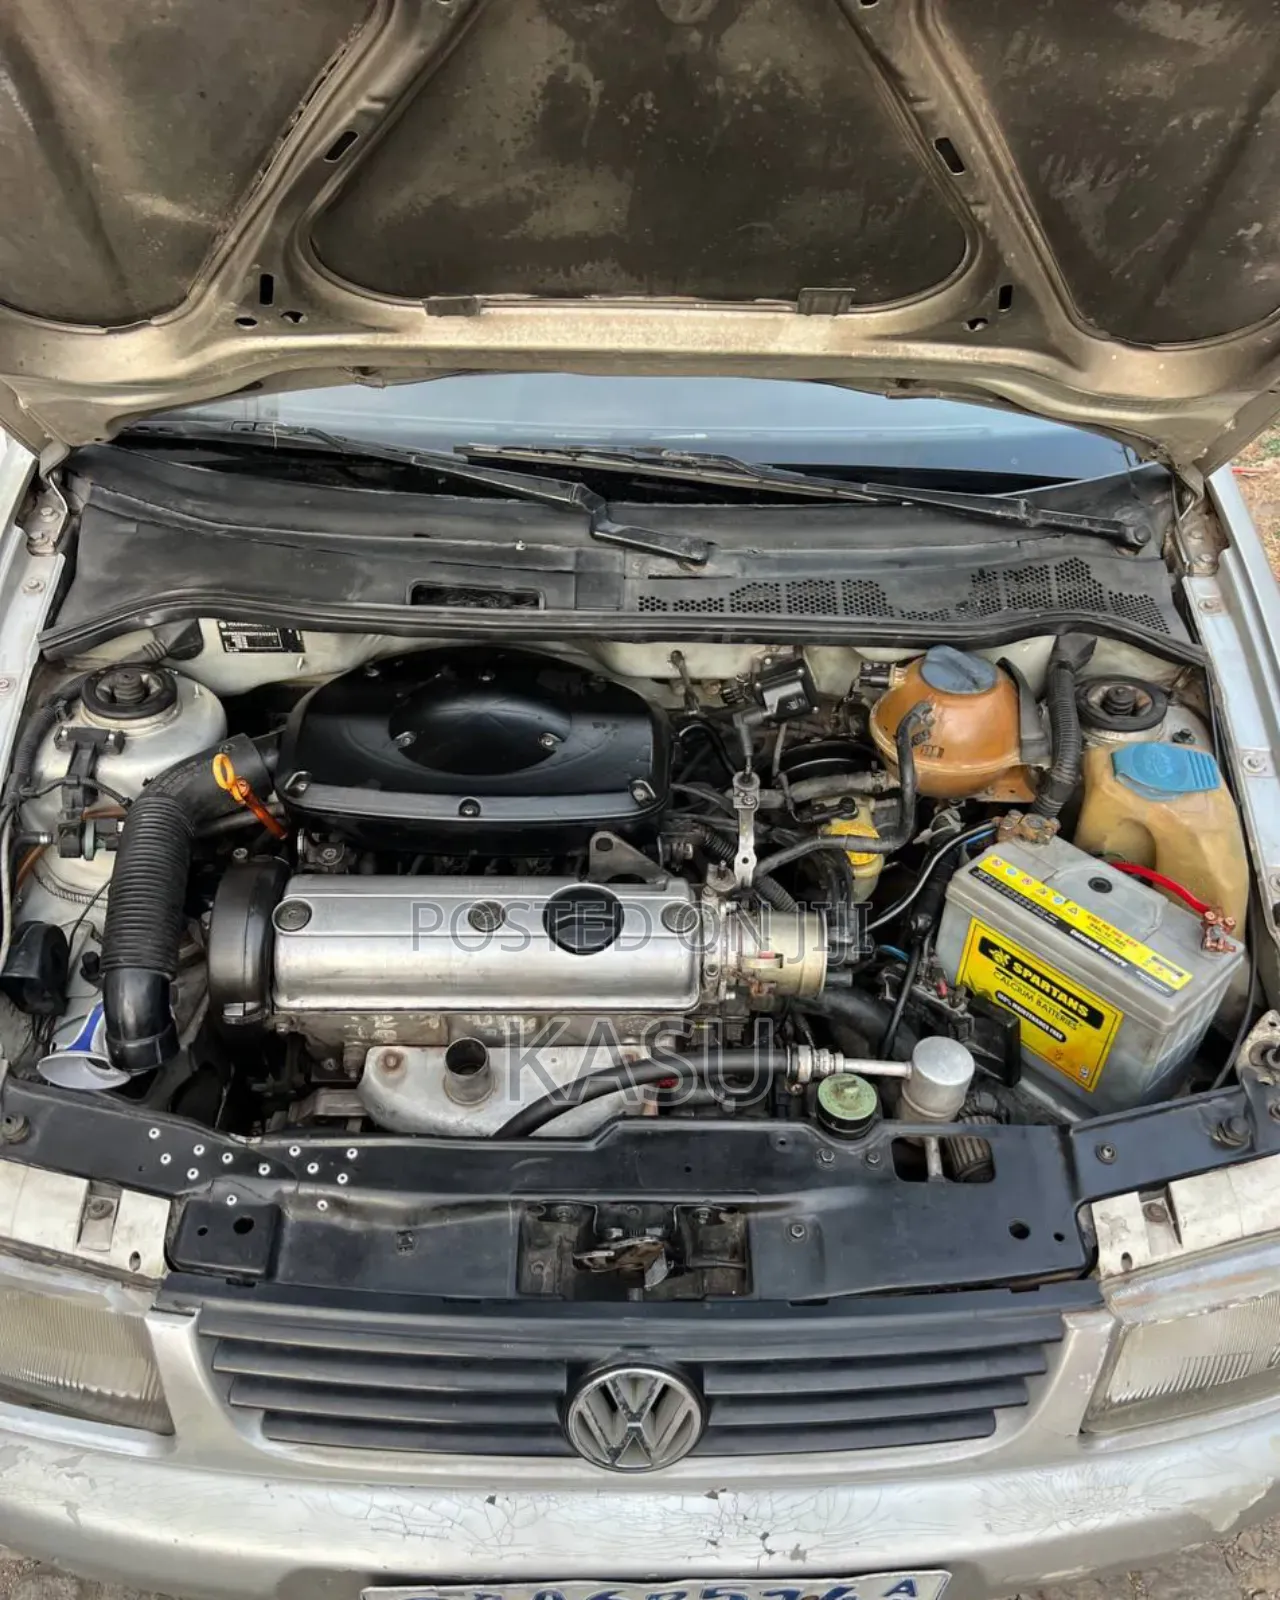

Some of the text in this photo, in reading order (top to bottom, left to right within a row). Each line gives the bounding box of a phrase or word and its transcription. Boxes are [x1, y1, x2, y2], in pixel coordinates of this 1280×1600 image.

[993, 970, 1034, 1003] CALCIUM
[1036, 999, 1078, 1031] BATTERIES
[1012, 961, 1089, 1018] SPARTANS
